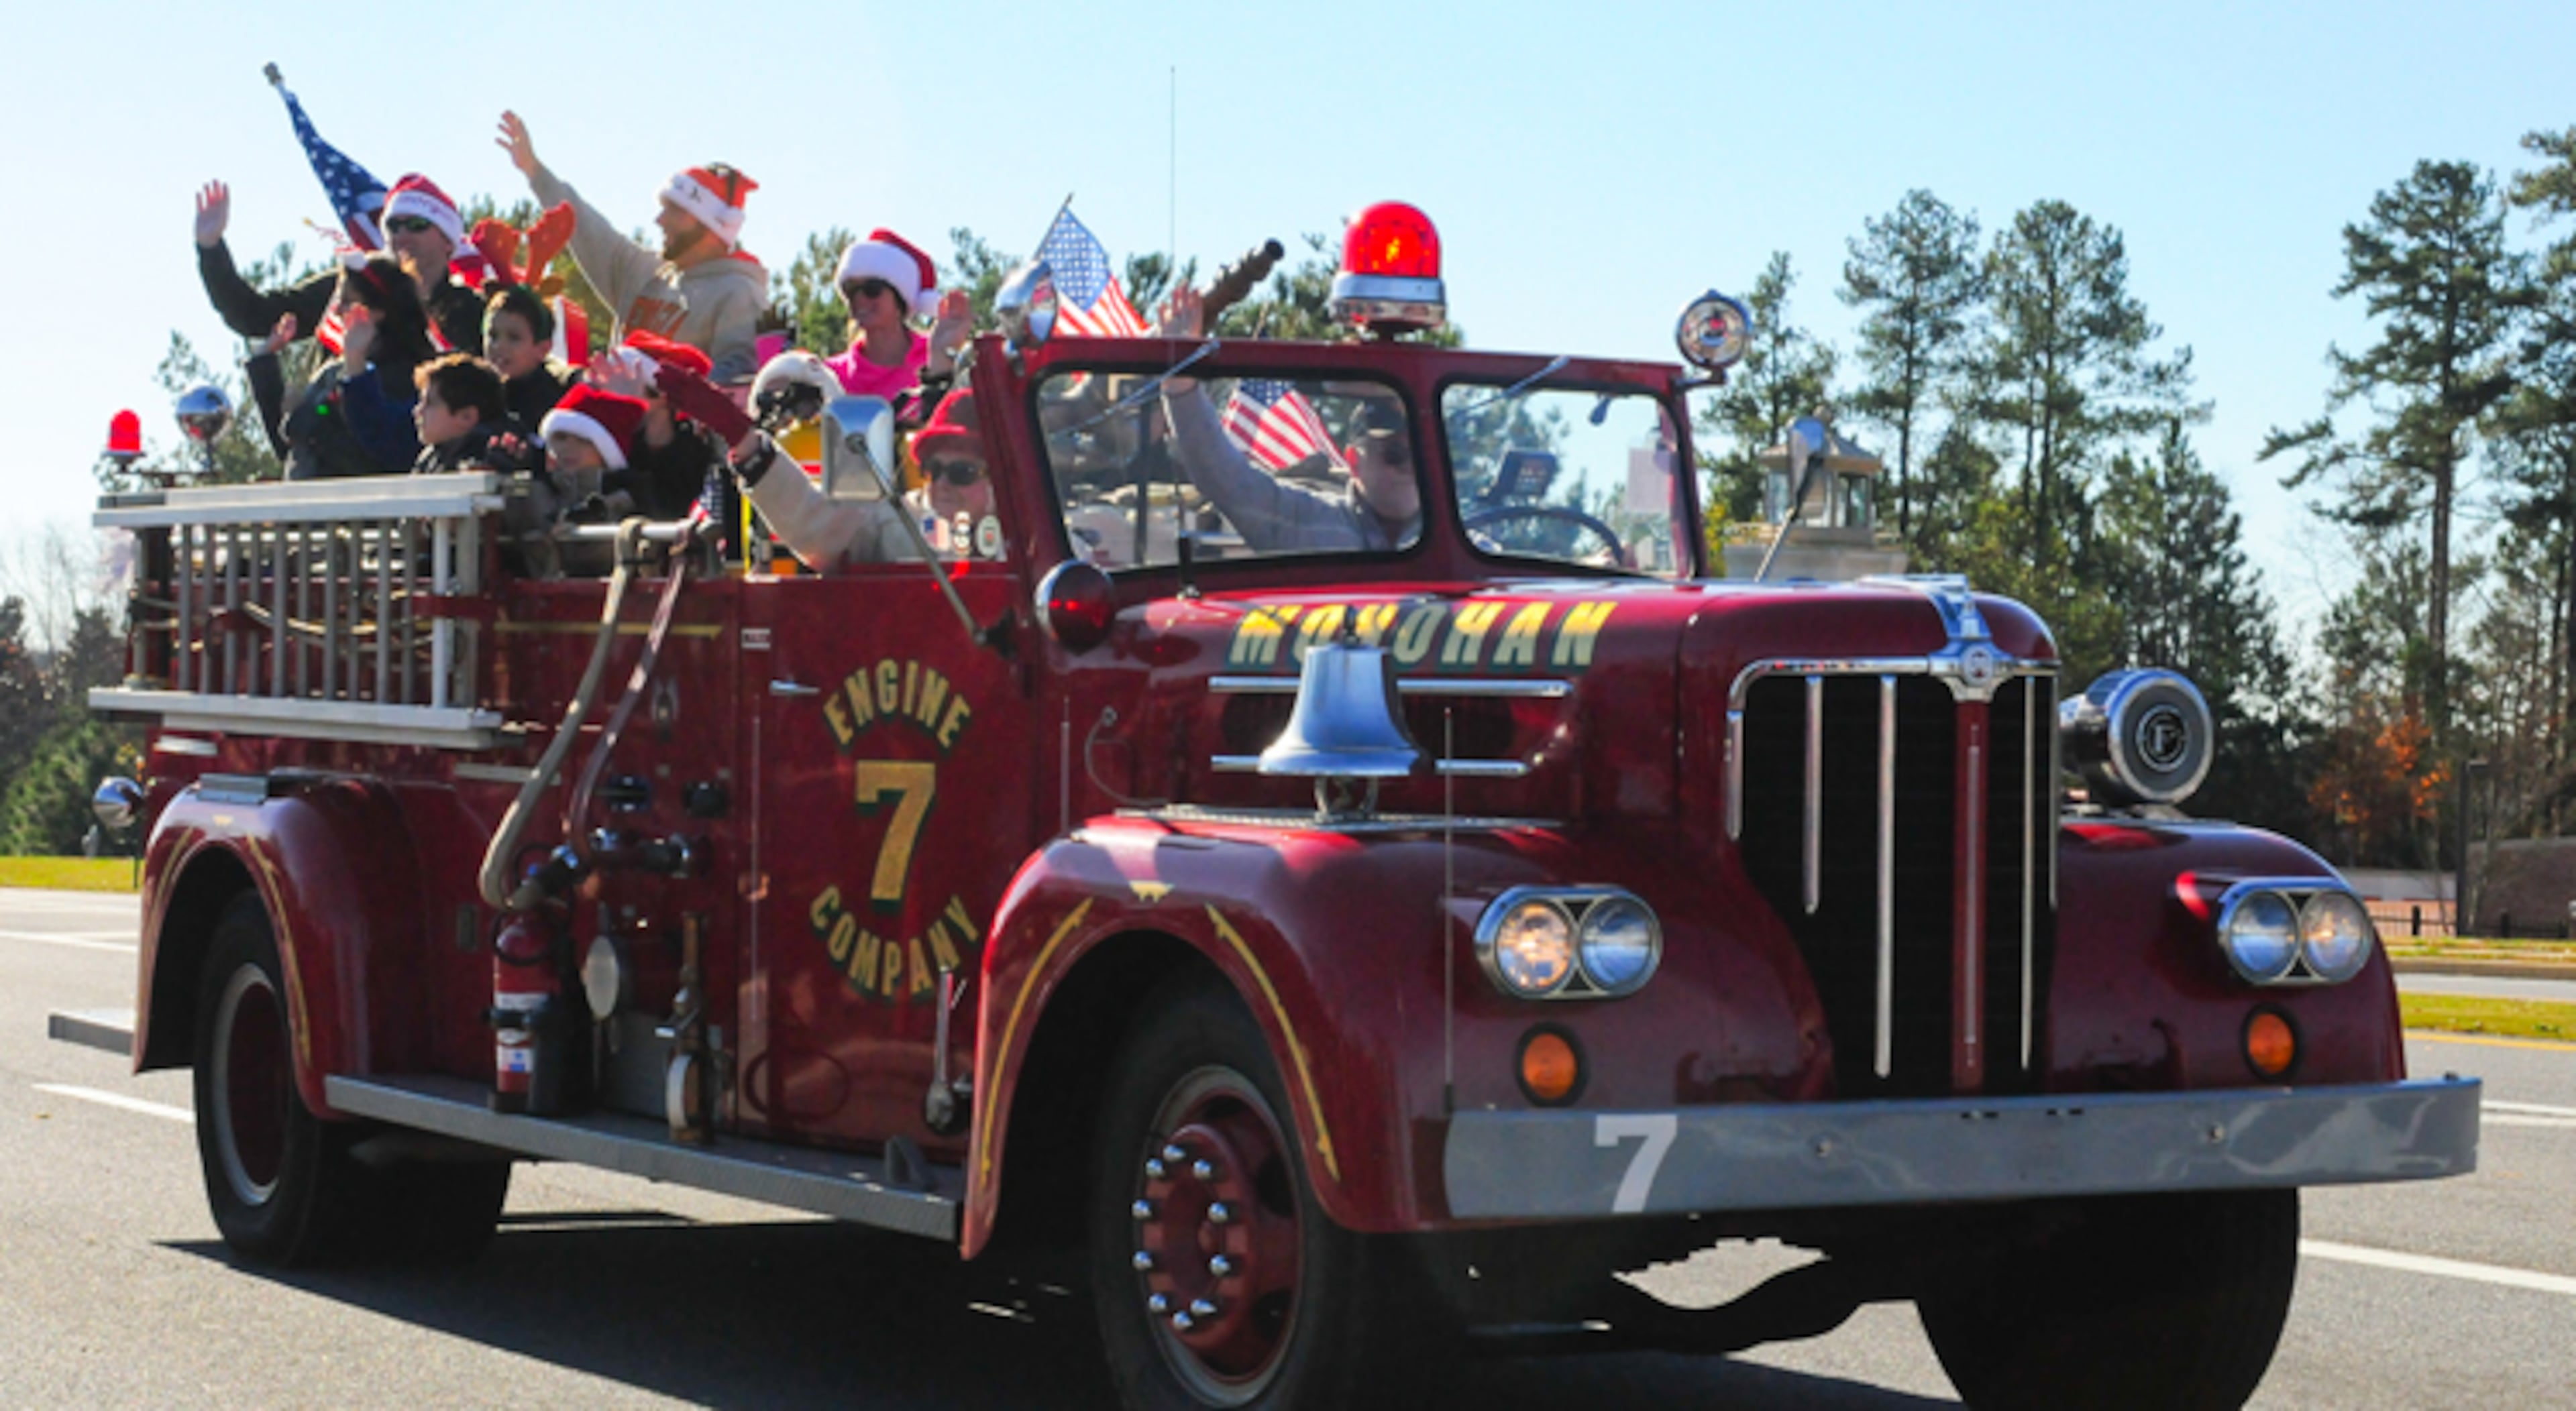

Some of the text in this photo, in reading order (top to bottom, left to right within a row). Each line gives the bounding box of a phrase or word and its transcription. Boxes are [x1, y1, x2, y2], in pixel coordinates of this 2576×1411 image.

[822, 659, 971, 748] ENGINE
[855, 759, 936, 901] 7
[810, 885, 979, 997] COMPANY
[1595, 1113, 1677, 1213] 7
